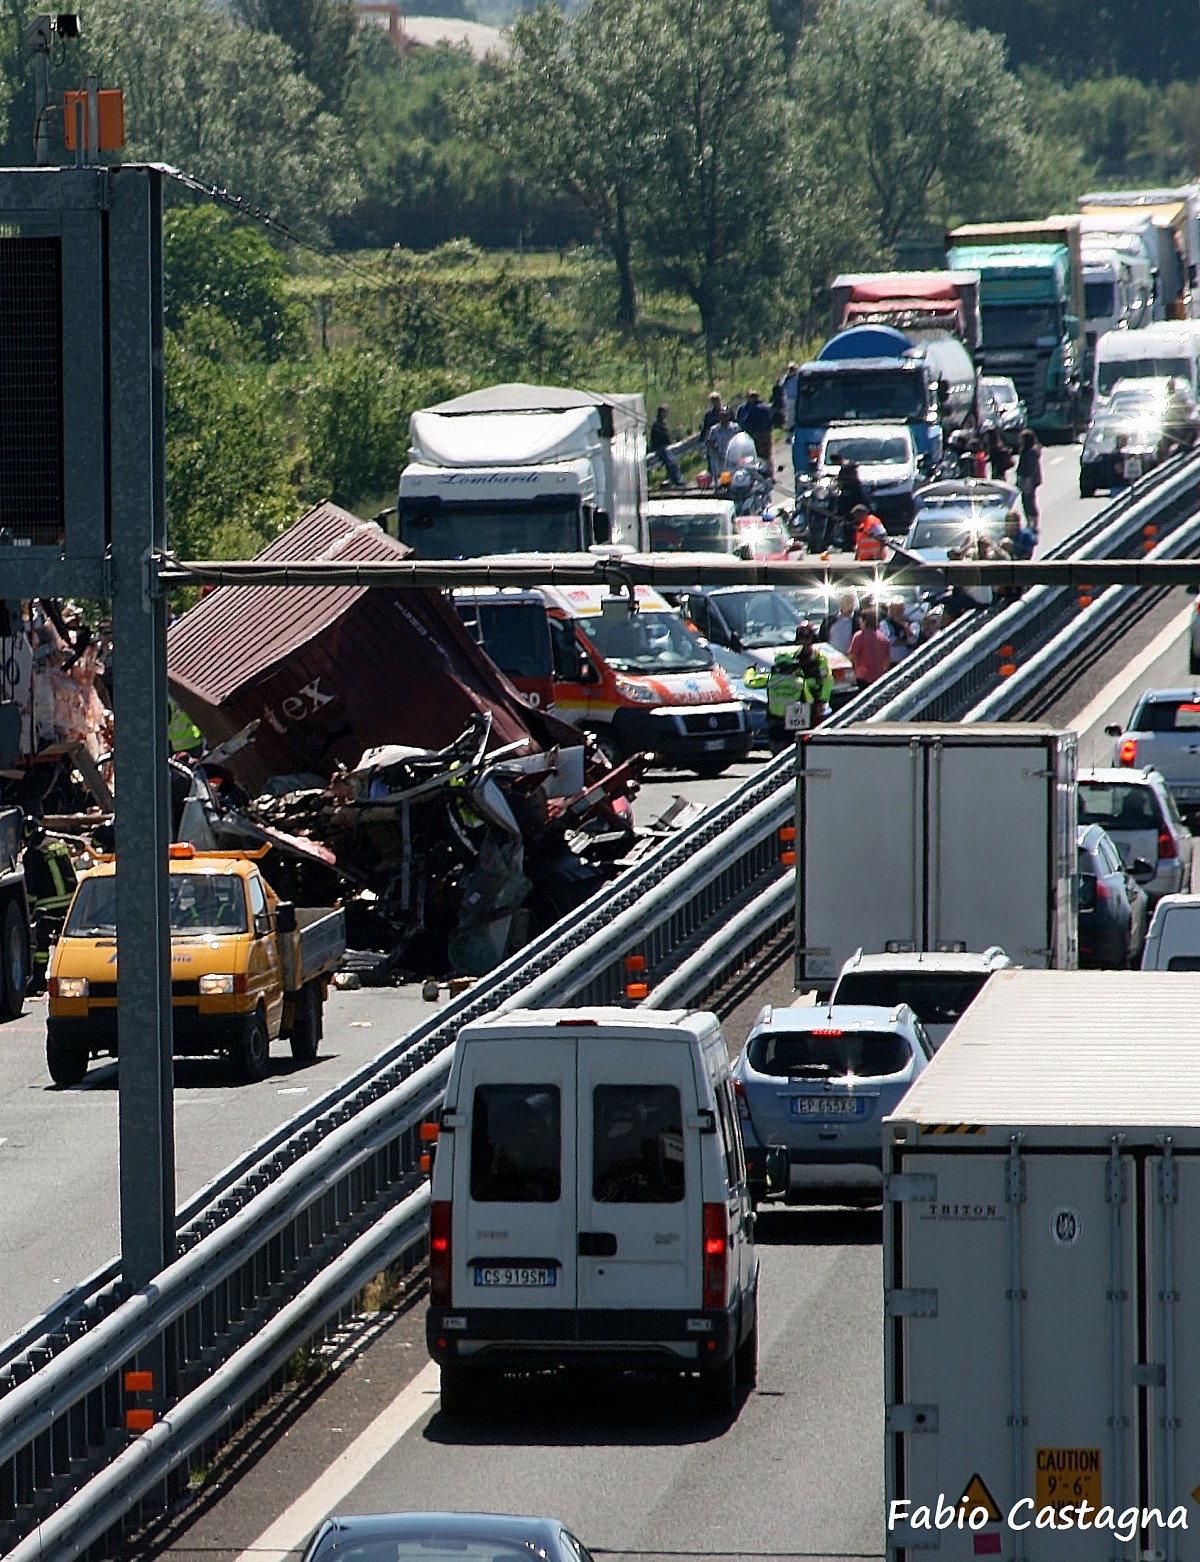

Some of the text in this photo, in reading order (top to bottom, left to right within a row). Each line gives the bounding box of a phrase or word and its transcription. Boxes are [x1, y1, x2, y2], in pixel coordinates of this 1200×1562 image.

[929, 1204, 997, 1216] TRITON
[484, 1269, 546, 1284] CS 919SM
[1037, 1449, 1099, 1472] CAUTION
